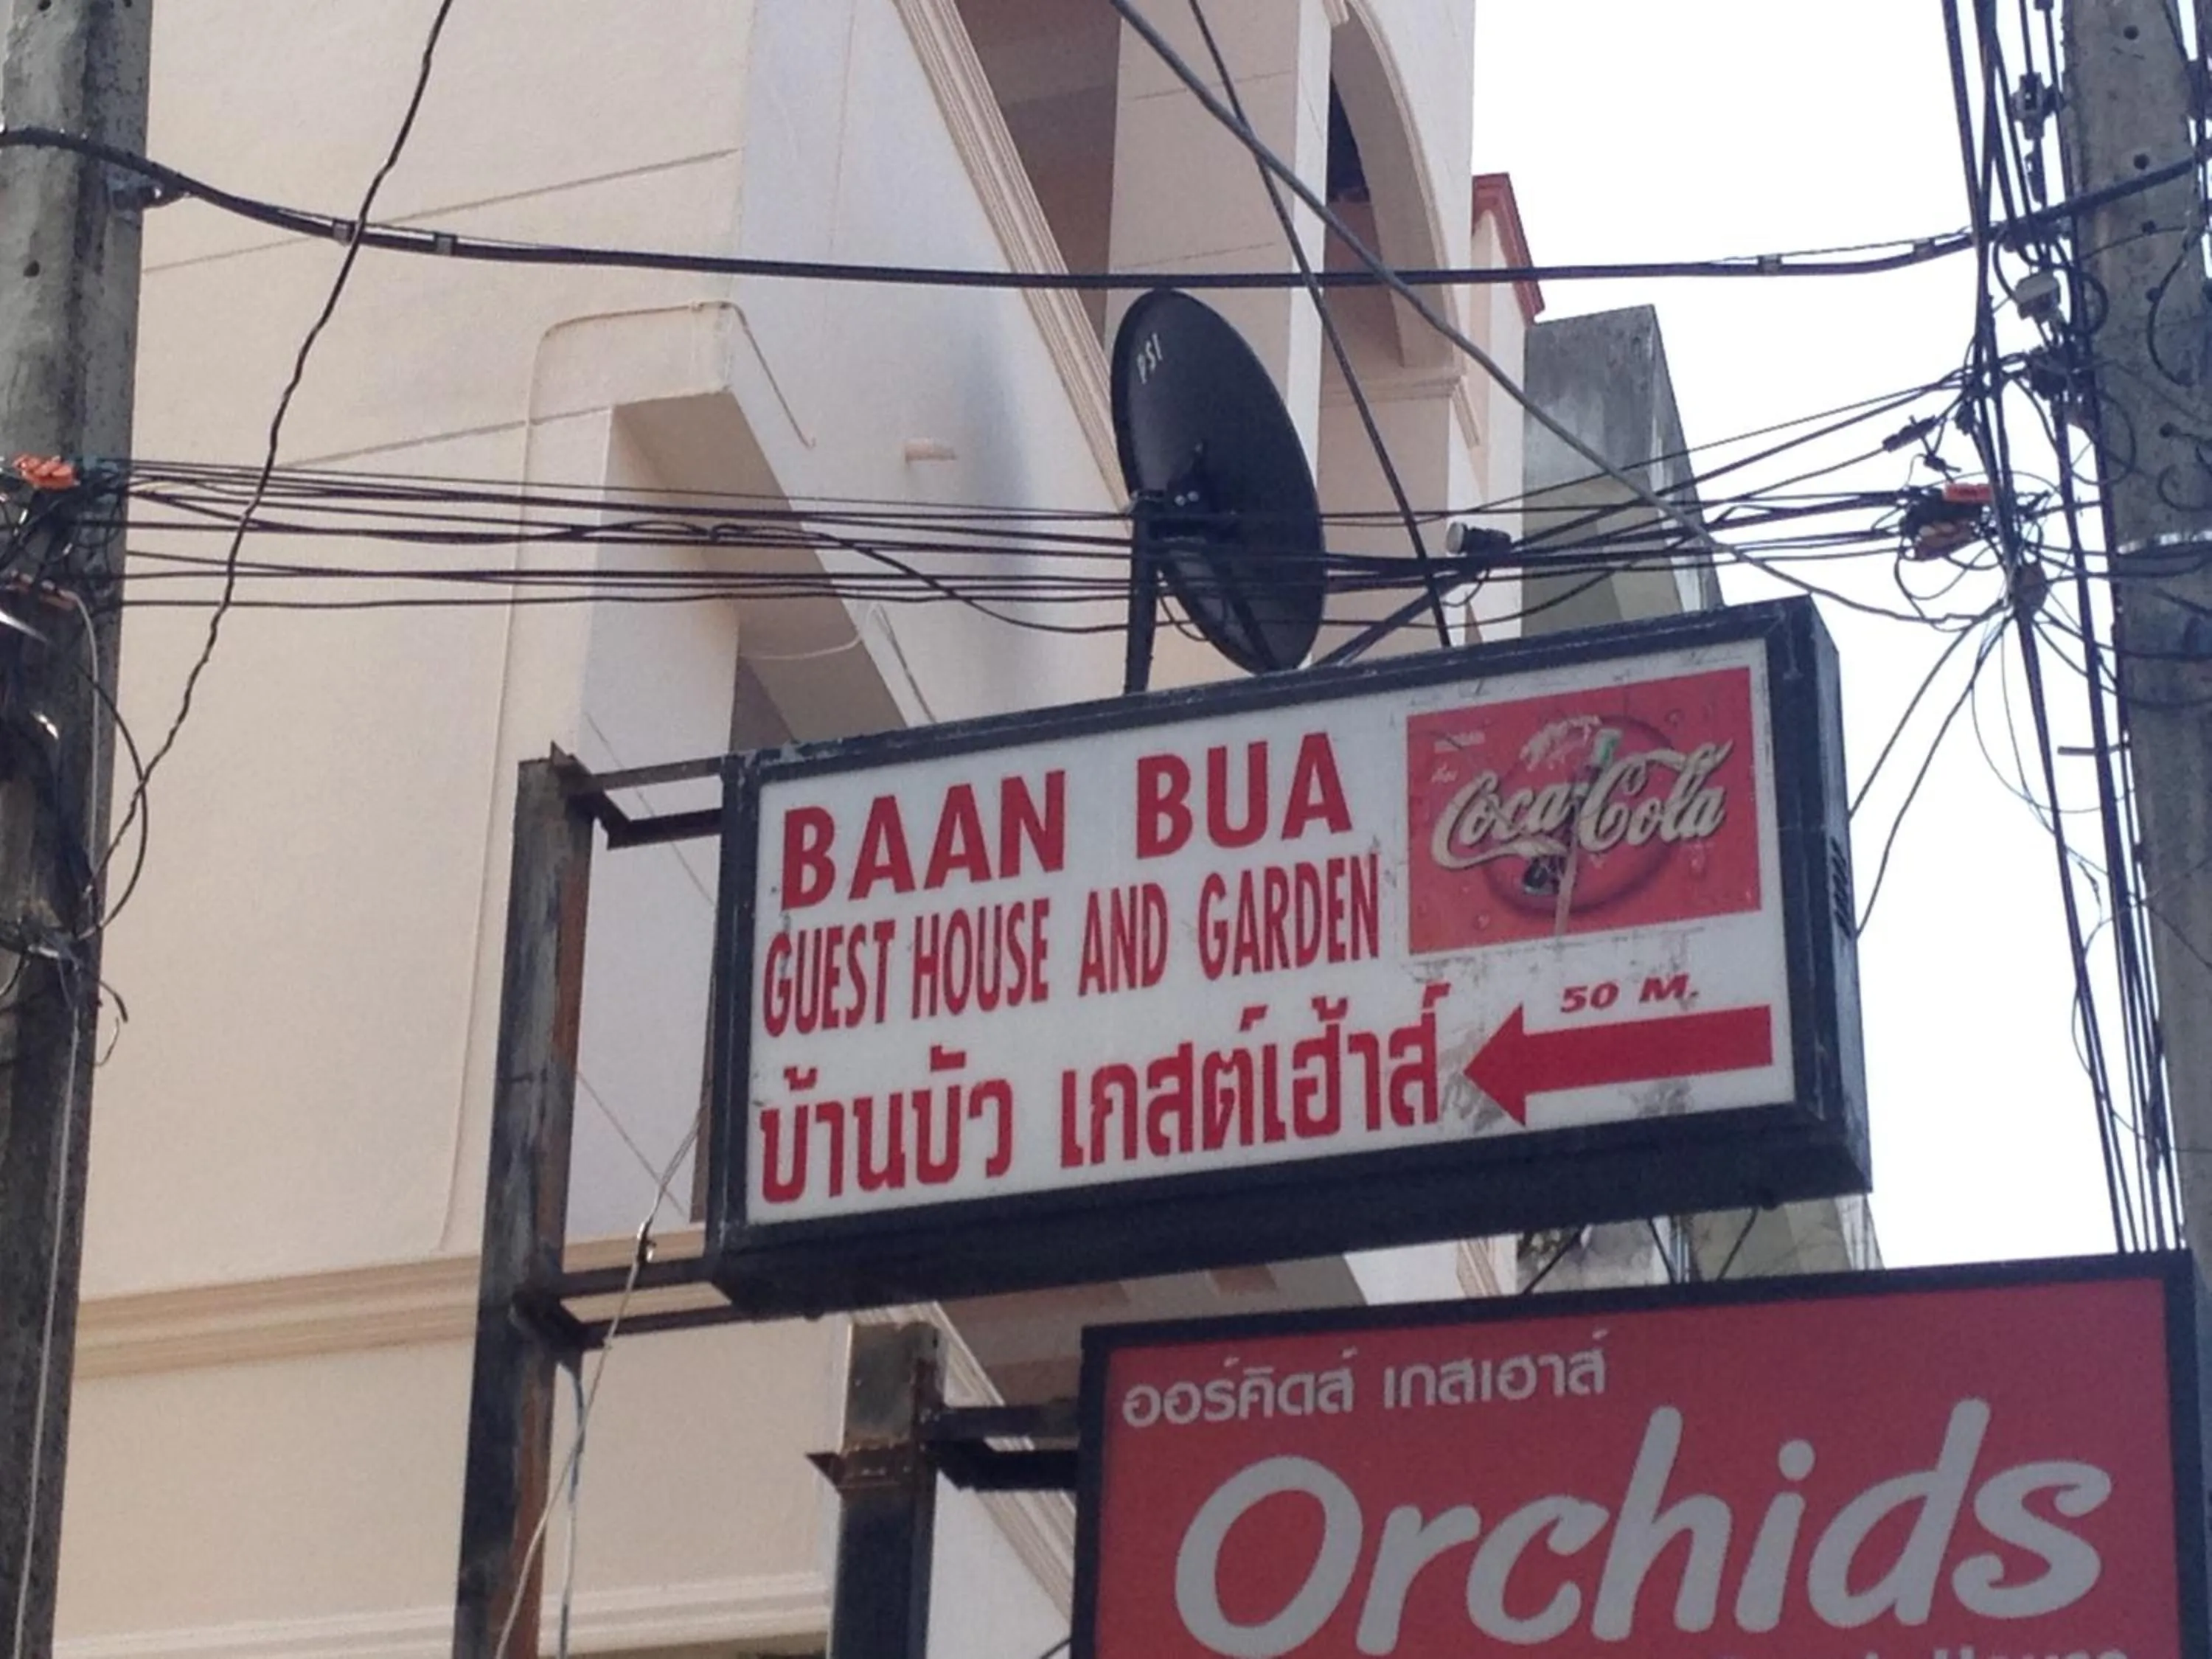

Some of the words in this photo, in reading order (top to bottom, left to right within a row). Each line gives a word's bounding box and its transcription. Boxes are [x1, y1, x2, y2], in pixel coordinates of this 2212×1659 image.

[1136, 332, 1164, 385] PSI
[780, 769, 1066, 911] BAAN
[1135, 731, 1352, 860] BUA
[762, 919, 897, 1037] GUEST
[911, 897, 1050, 1020] HOUSE
[1078, 882, 1169, 997] AND
[1197, 852, 1380, 981] GARDEN
[1560, 981, 1620, 1014] 50
[759, 1043, 1015, 1205] บ้านบัว
[1060, 981, 1452, 1169] เกสต์เฮ้าส์
[1121, 1346, 1358, 1428] ออร์คิดส์
[1174, 1397, 2113, 1659] Orchids
